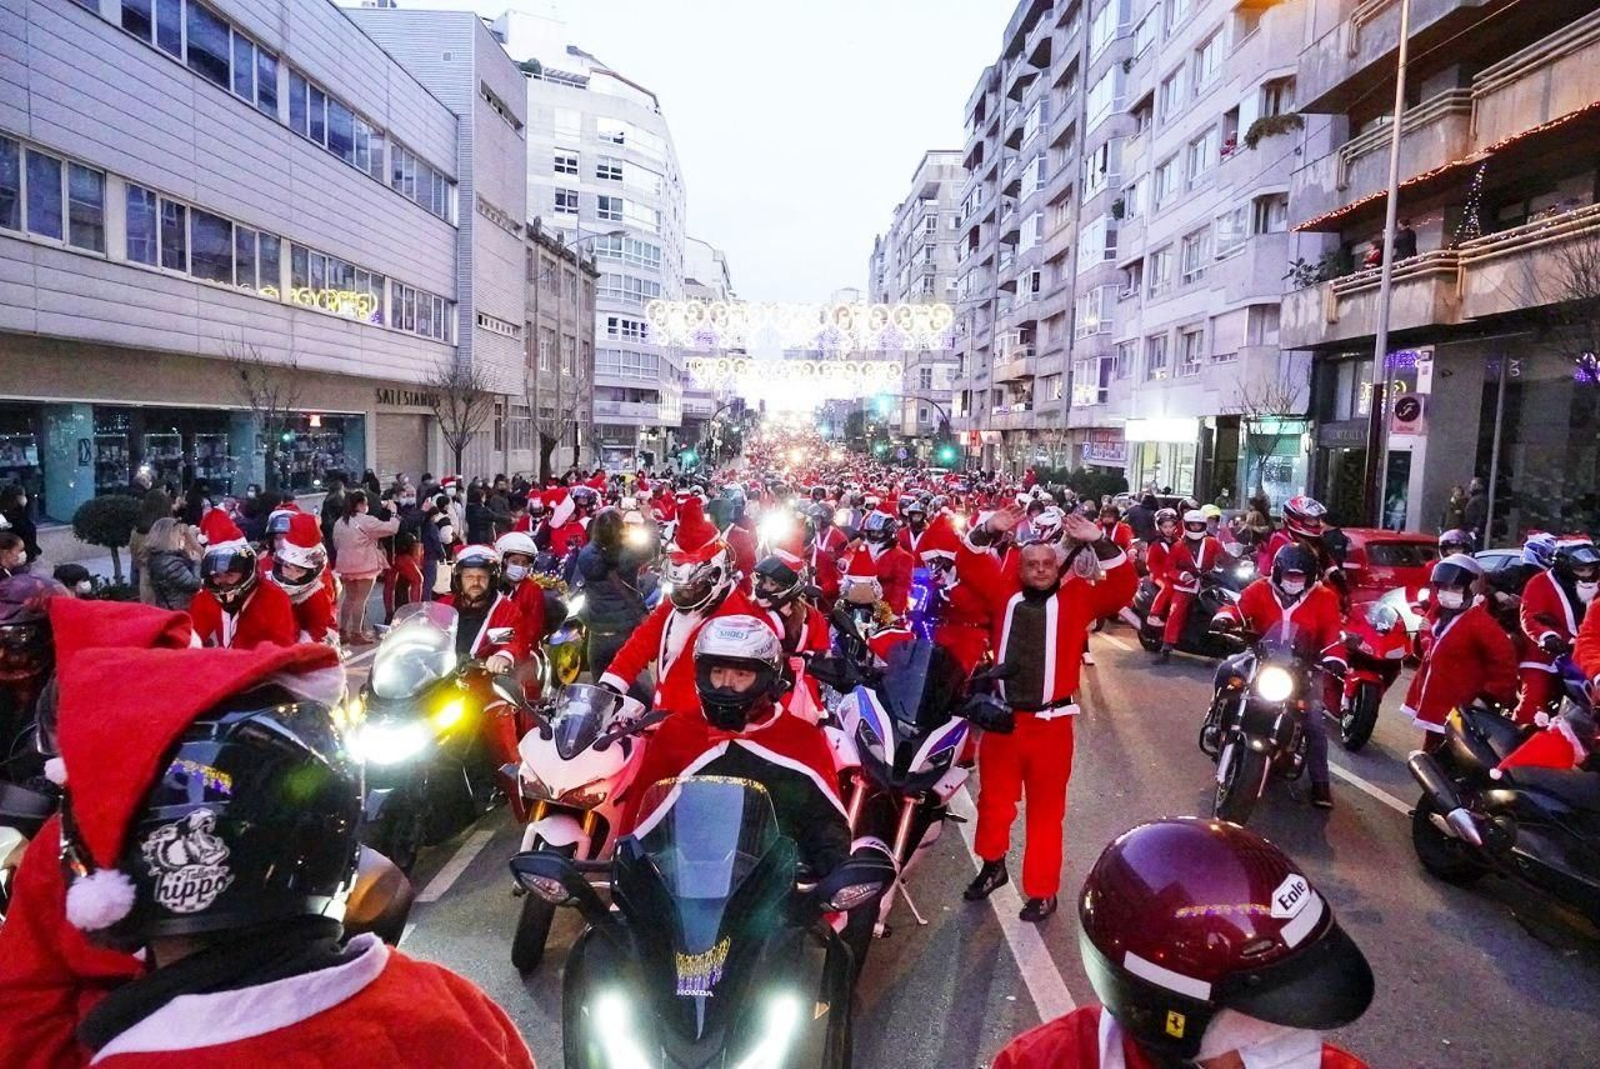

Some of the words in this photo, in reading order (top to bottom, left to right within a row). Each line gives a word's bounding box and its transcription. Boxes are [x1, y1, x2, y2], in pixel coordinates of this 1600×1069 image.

[156, 874, 227, 906] hippo
[1278, 881, 1306, 911] Eole
[676, 989, 714, 997] HONDA
